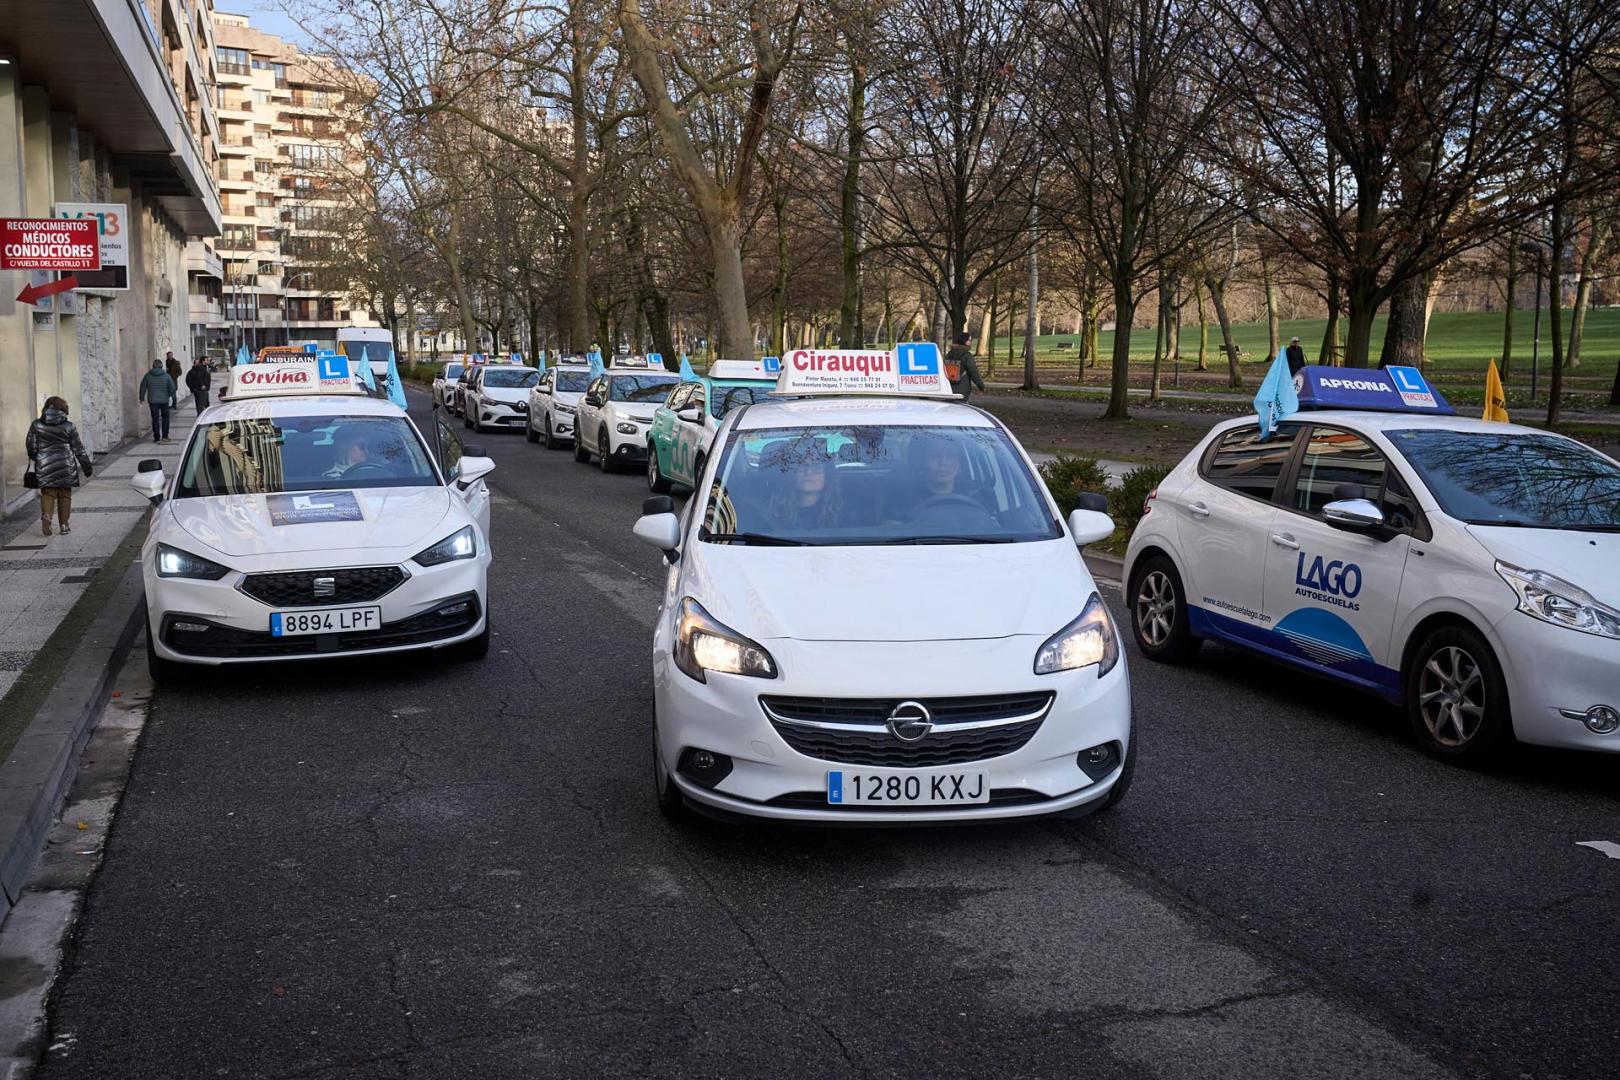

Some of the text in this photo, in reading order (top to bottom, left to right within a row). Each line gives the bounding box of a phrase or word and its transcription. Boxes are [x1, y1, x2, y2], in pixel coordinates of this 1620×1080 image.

[7, 221, 89, 231] RECONOCIMIENTOS
[23, 231, 71, 244] MÉDICOS
[4, 244, 94, 257] CONDUCTORES
[325, 360, 341, 376] L
[767, 360, 776, 370] L
[792, 350, 892, 376] Cirauqui
[907, 348, 928, 371] L
[240, 369, 308, 385] Orvina
[900, 375, 938, 385] PRACTICAS
[1320, 377, 1392, 393] APRONA
[1398, 370, 1420, 390] L
[1296, 551, 1362, 599] LAGO
[1295, 587, 1360, 612] AUTOESCUELAS
[1203, 595, 1272, 623] www.autoescuelalago.com
[286, 613, 334, 632] 8894
[340, 610, 375, 629] LPF
[852, 775, 920, 800] 1280
[931, 773, 983, 800] KXJ
